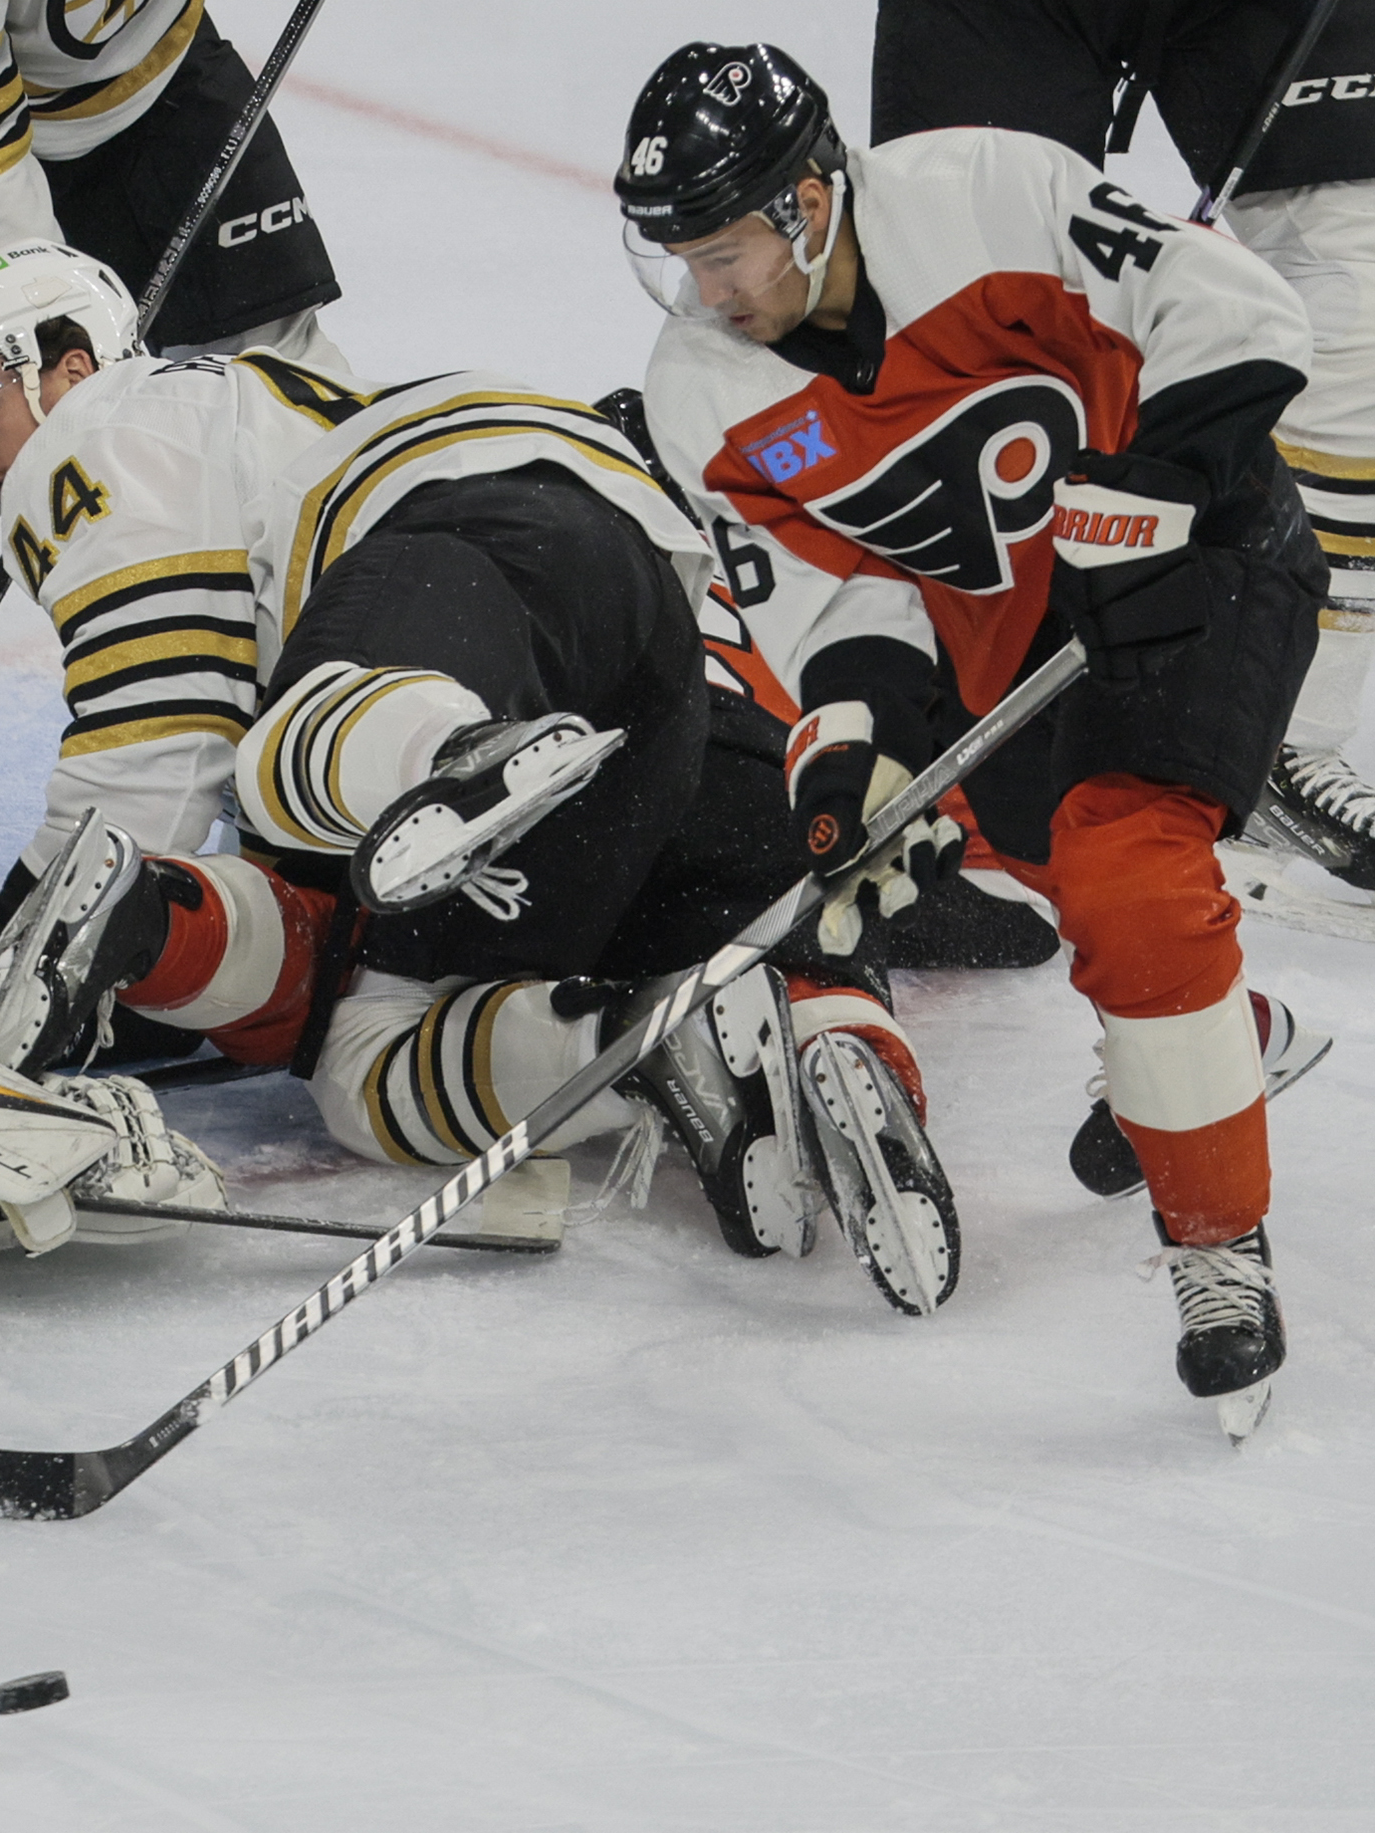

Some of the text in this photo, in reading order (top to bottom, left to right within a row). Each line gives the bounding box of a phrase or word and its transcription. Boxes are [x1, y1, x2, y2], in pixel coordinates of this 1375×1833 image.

[1280, 73, 1375, 108] CC
[631, 136, 668, 177] 46
[7, 245, 51, 260] Bank
[746, 420, 838, 484] IBX
[8, 455, 112, 605] 44
[1268, 804, 1326, 856] BAUER
[667, 1078, 714, 1143] BAUER
[208, 1119, 530, 1404] WARRIOR
